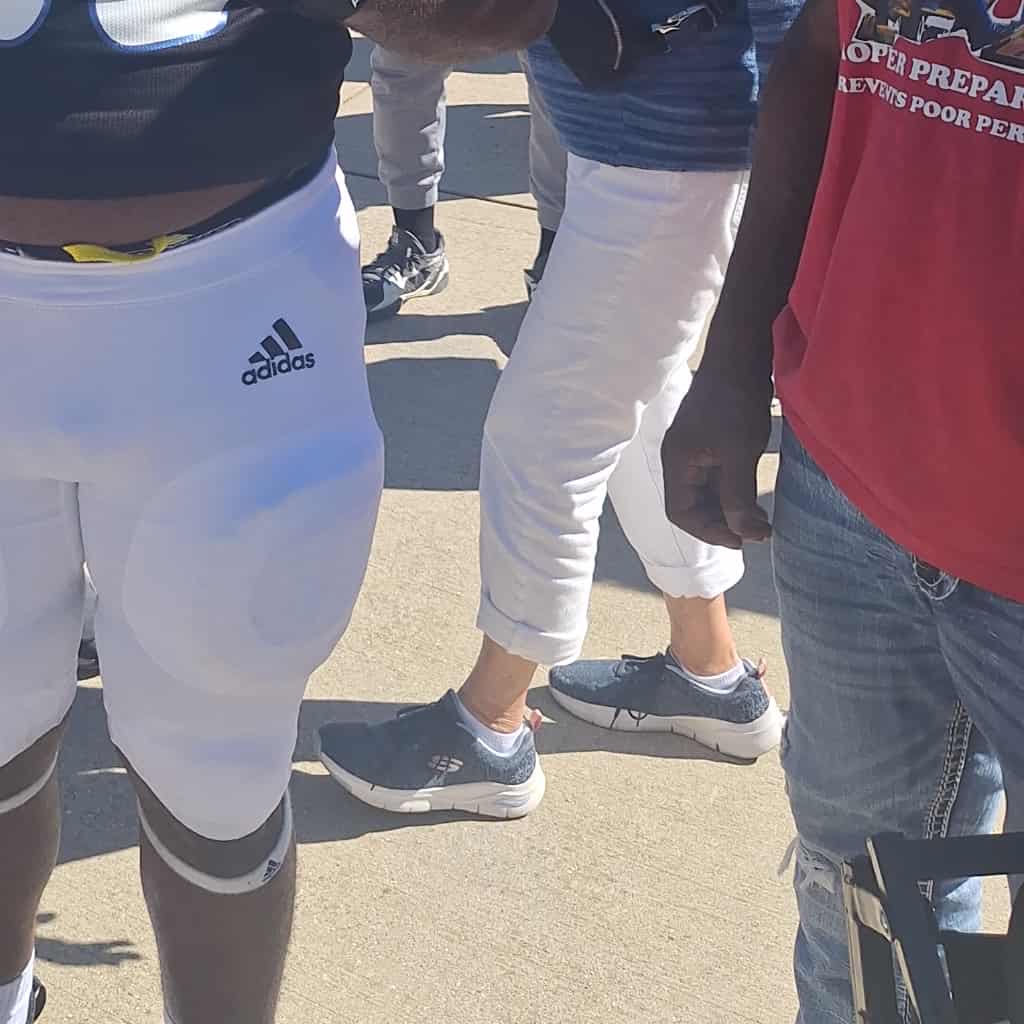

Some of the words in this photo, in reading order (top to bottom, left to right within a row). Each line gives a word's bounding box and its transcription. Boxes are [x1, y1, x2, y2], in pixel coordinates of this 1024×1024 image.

[841, 41, 908, 77] OPER
[909, 95, 972, 130] POOR
[240, 350, 317, 387] adidas
